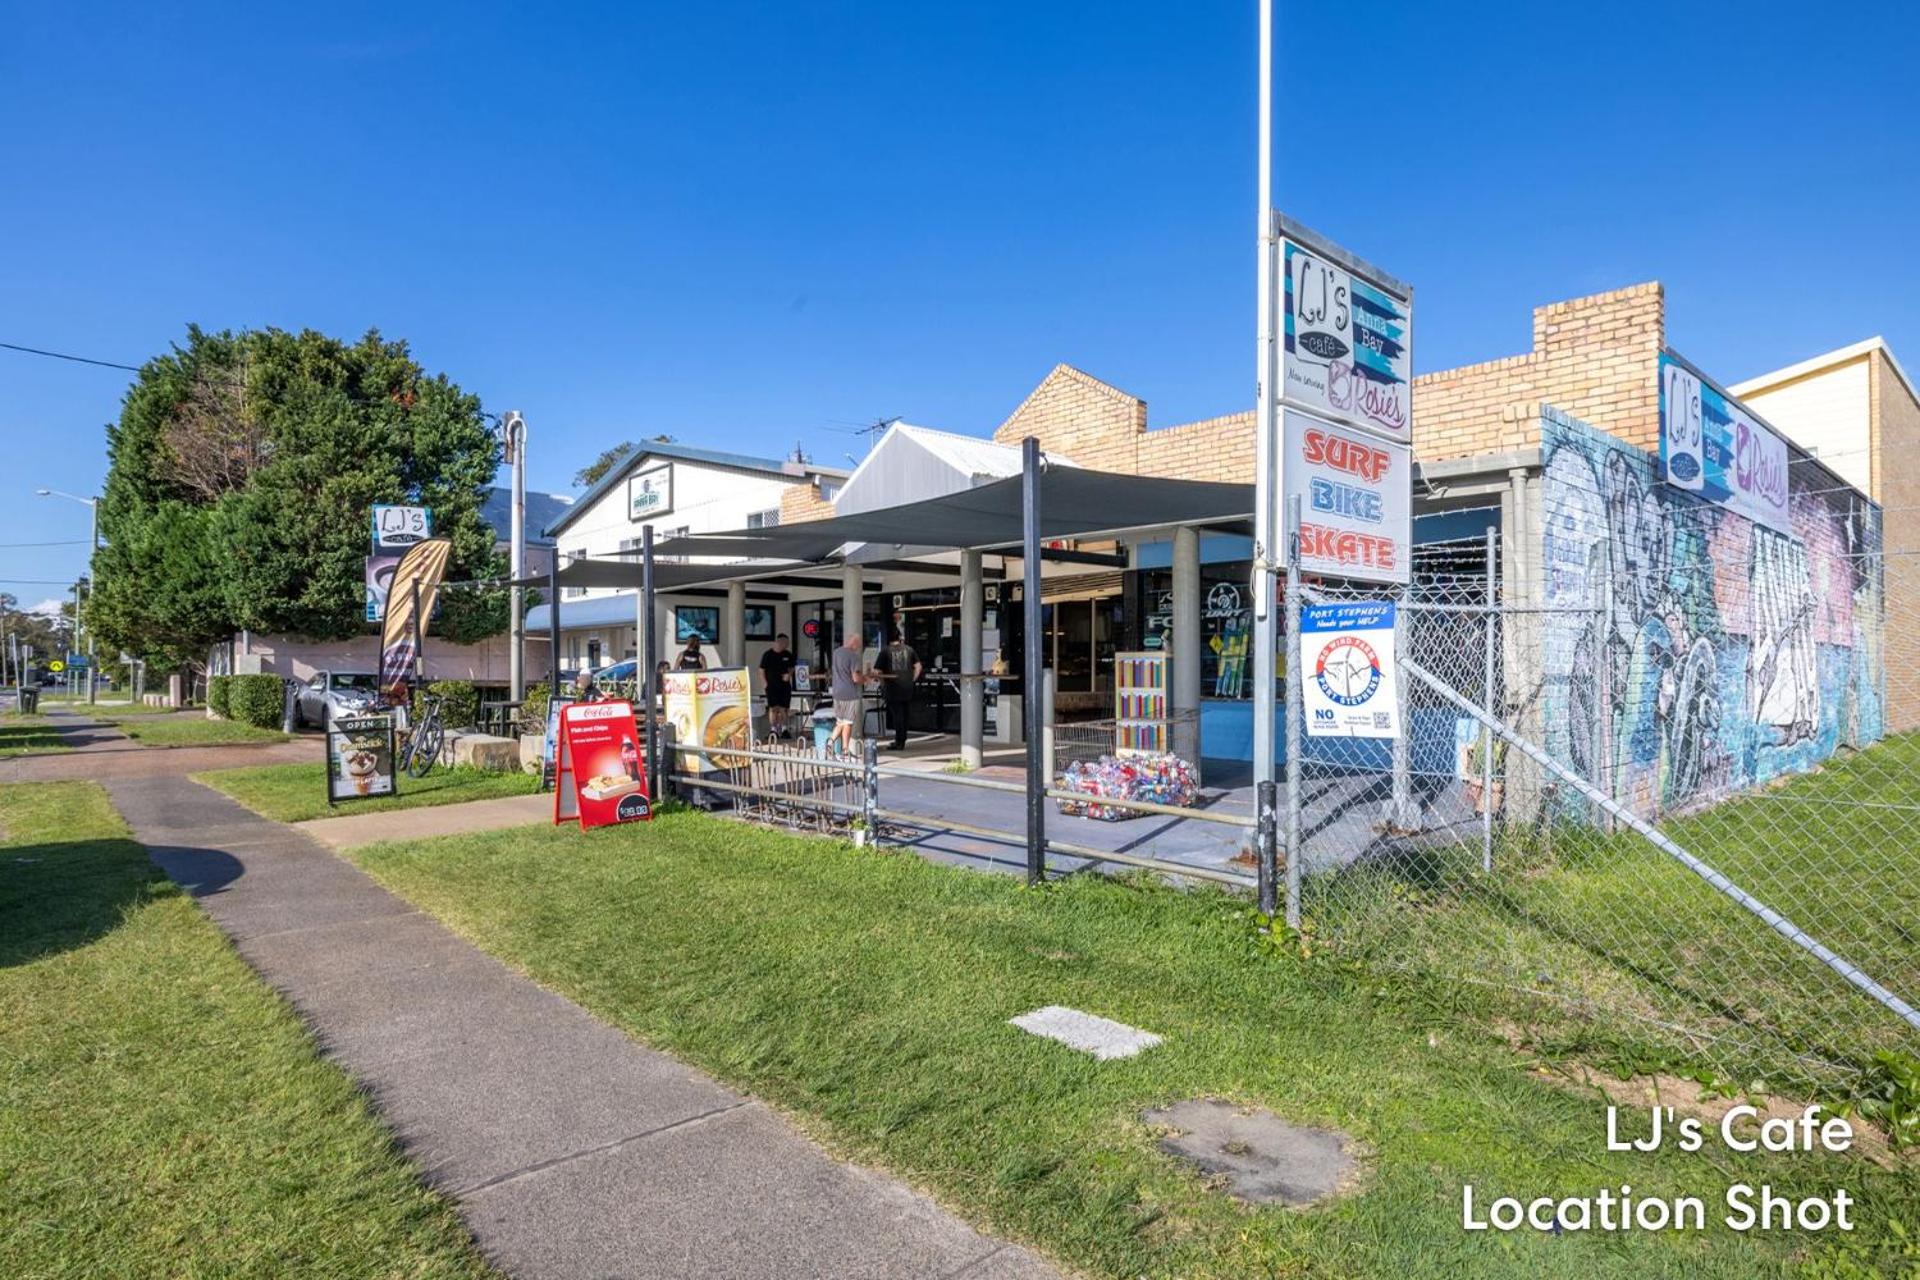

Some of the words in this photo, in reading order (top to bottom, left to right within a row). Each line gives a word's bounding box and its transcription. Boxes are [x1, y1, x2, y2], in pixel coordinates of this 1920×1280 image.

[1298, 257, 1348, 331] LJ's
[1355, 306, 1386, 333] Anna
[1308, 334, 1336, 357] café
[1361, 329, 1384, 356] Bay
[1355, 369, 1406, 427] Rosie's
[1669, 371, 1700, 448] LJ's
[1303, 428, 1391, 483] SURF
[1311, 476, 1383, 523] BIKE
[382, 508, 424, 533] LJ's
[1300, 522, 1395, 569] SKATE
[1310, 609, 1334, 619] PORT
[1337, 606, 1388, 617] STEPHENS
[1357, 617, 1379, 625] HELP
[1339, 676, 1380, 705] STEPHENS
[347, 721, 374, 729] OPEN
[1315, 709, 1334, 720] NO
